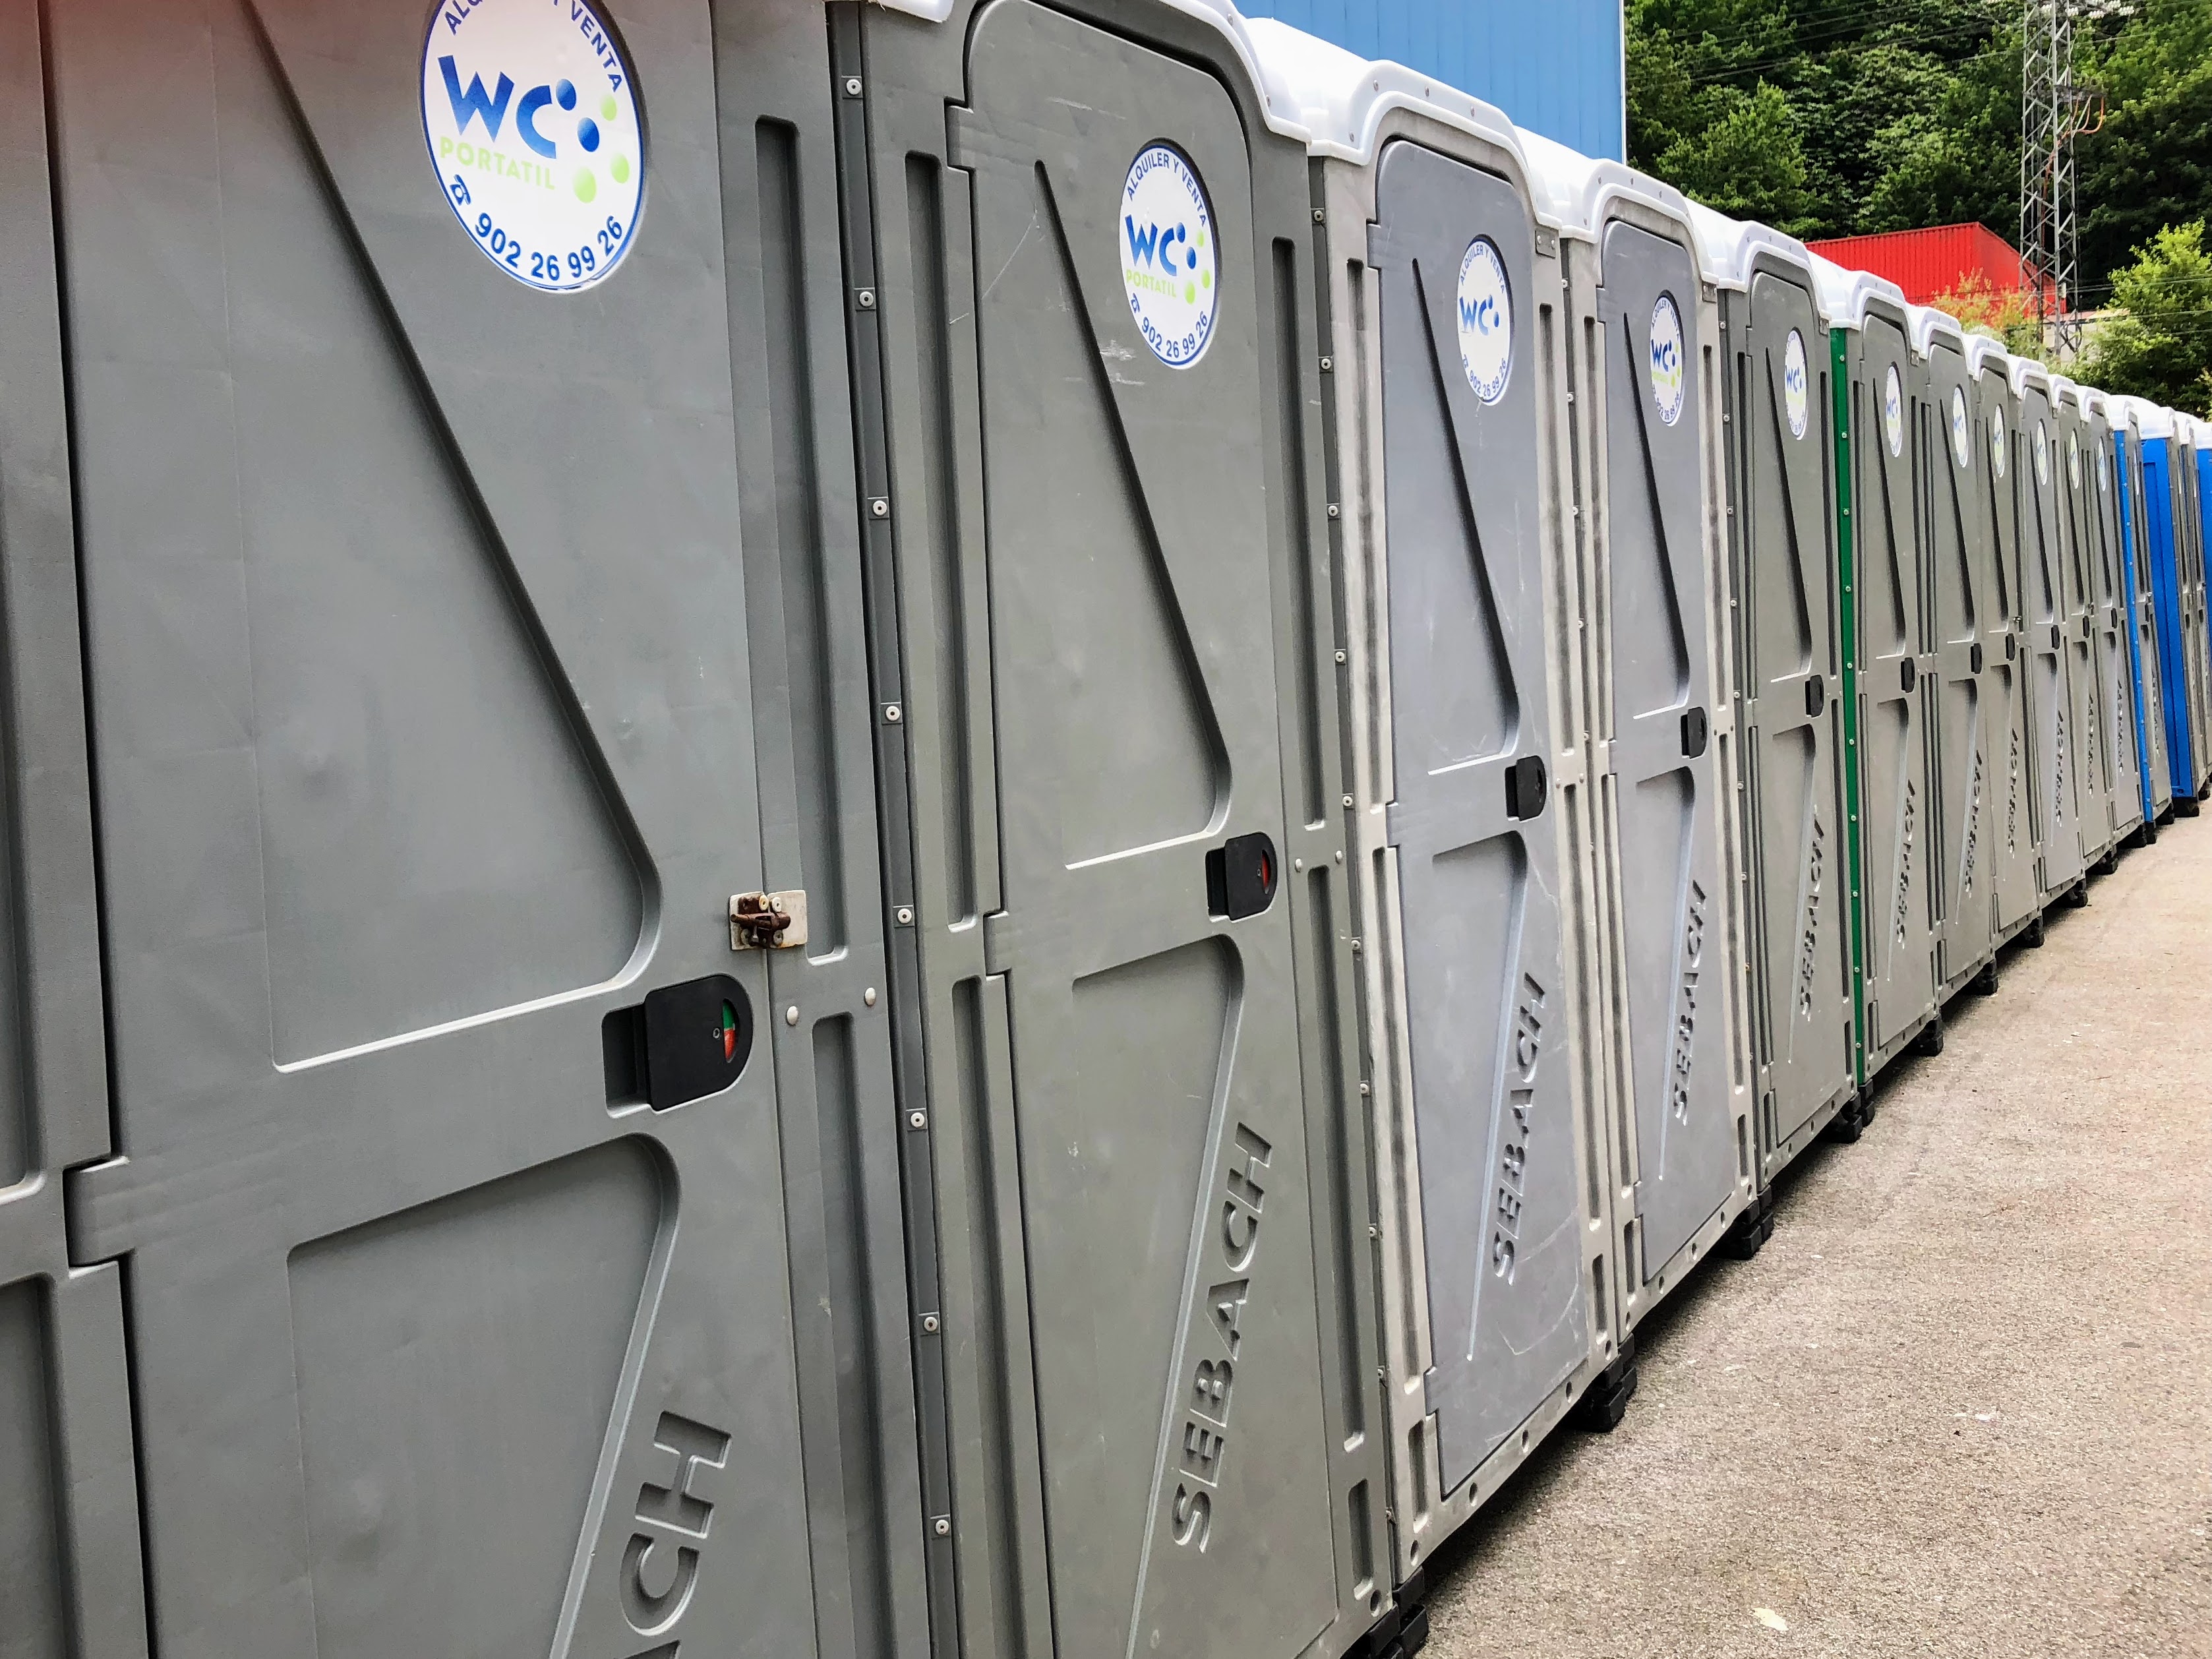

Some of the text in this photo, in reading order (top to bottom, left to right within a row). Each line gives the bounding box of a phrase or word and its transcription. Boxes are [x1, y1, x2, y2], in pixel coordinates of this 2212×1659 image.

[570, 0, 622, 93] VENTA
[436, 55, 557, 160] WC
[440, 136, 555, 191] PORTATIL
[1126, 152, 1207, 227] ALQUILER Y VENTA
[474, 212, 623, 282] 902 26 99 26
[1124, 214, 1177, 277] WC
[1460, 244, 1505, 294] ALQUILER Y VENTA
[1126, 268, 1177, 298] PORTATIL
[1459, 295, 1489, 336] WC
[1141, 310, 1208, 359] 902 26 99 26
[1651, 339, 1669, 373] WC
[1469, 357, 1506, 396] 902 26 99 26
[1785, 365, 1798, 393] WC
[1799, 818, 1824, 1022] SEBACH
[1673, 879, 1707, 1127] SEBACH
[1492, 971, 1546, 1286] SEBACH
[1170, 1121, 1272, 1553] SEBACH
[617, 1410, 732, 1659] CH
